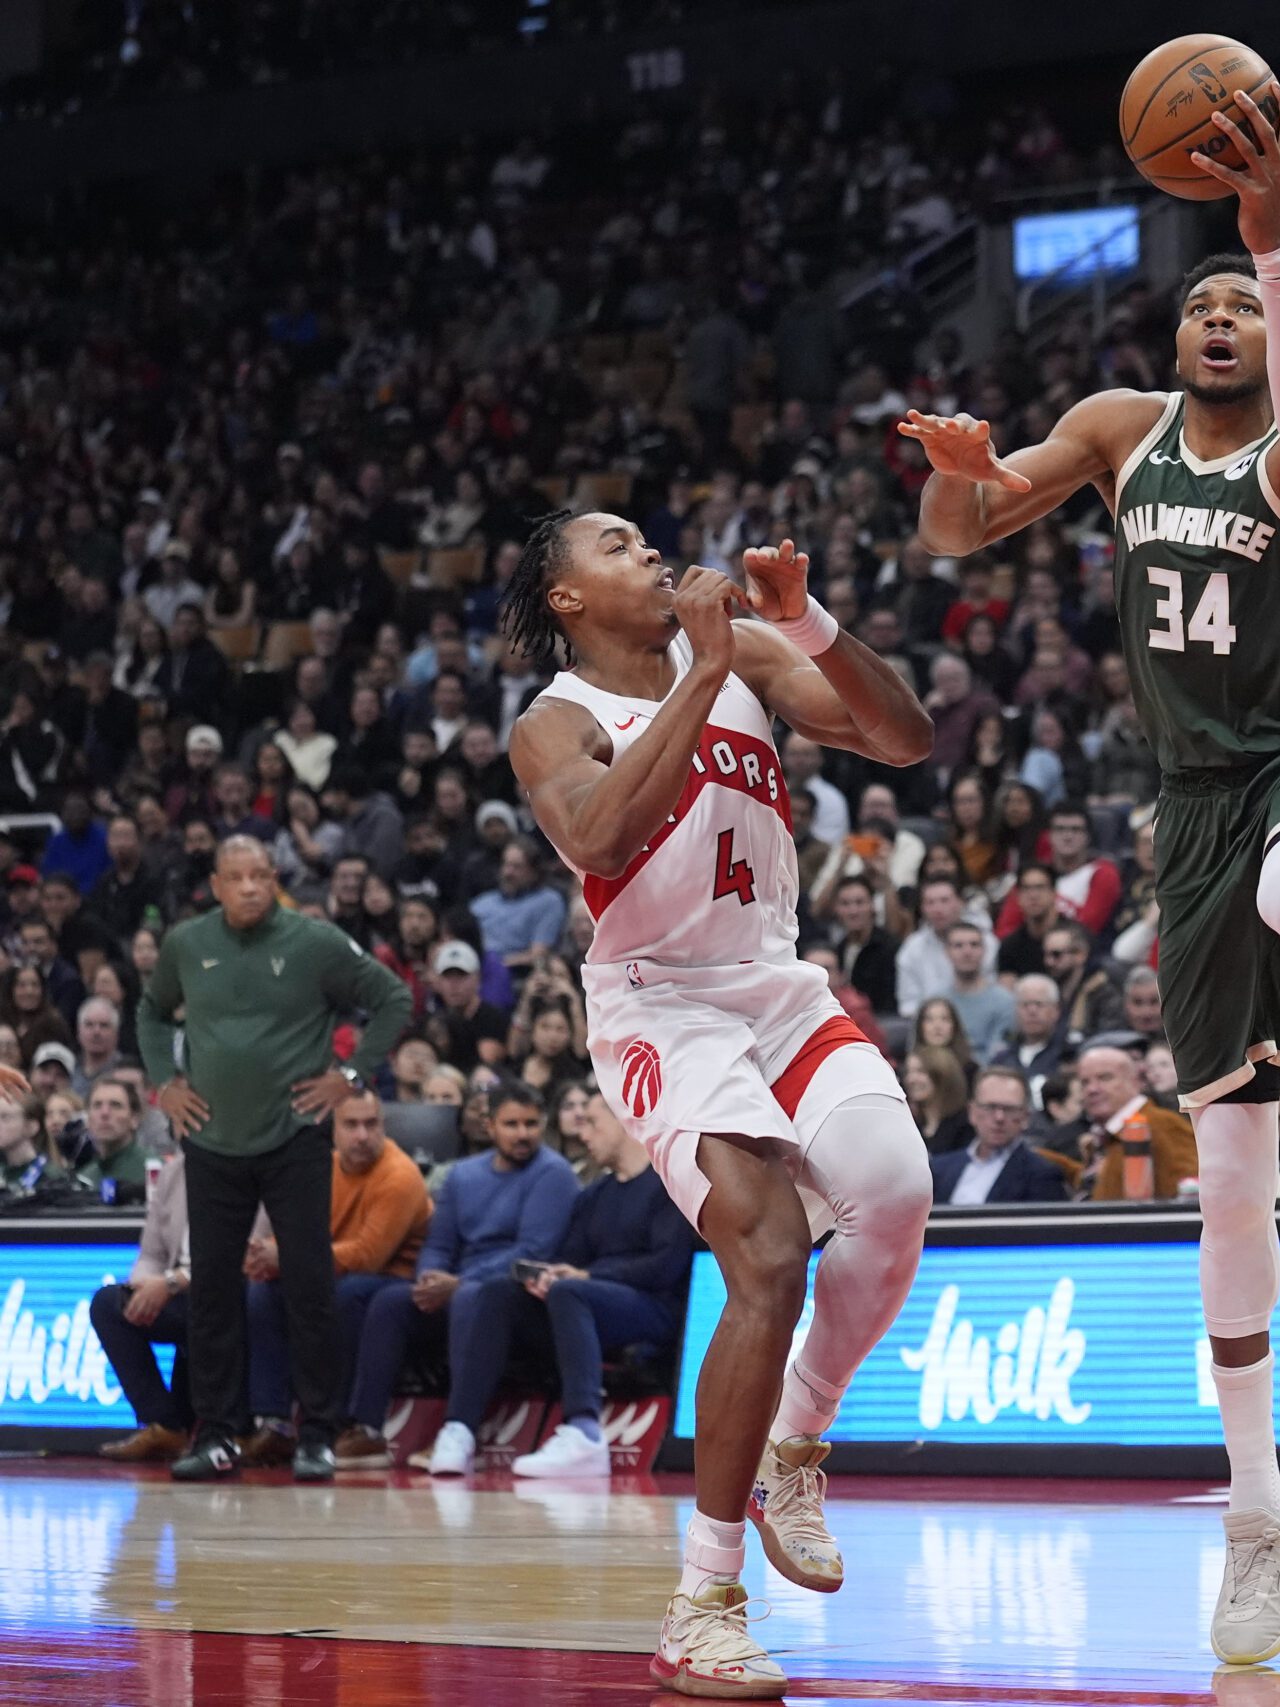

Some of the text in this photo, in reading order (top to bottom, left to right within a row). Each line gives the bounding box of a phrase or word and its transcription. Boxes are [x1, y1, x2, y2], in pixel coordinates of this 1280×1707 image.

[1120, 502, 1276, 563] MILWAUKEE
[1146, 566, 1237, 655] 34
[713, 828, 756, 906] 4
